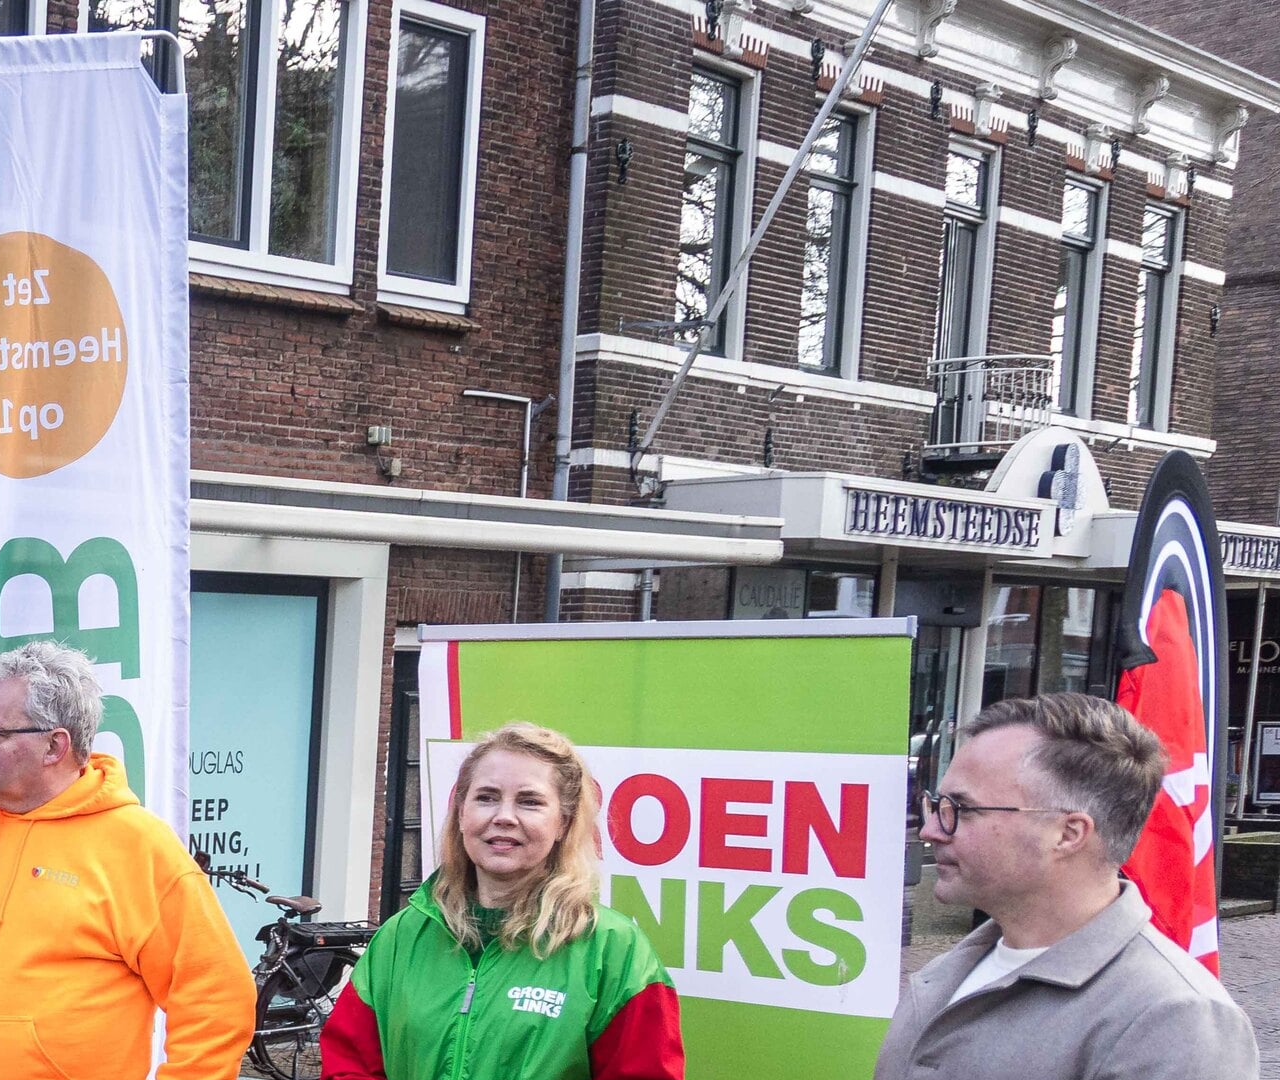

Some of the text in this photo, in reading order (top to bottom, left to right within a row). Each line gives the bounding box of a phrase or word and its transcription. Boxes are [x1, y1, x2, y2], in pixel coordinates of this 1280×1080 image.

[850, 490, 1041, 548] HEEMSTEEDSE
[189, 750, 244, 775] UGLAS
[191, 798, 229, 822] EEP
[597, 772, 870, 879] OEN
[189, 831, 249, 857] NING,
[609, 873, 868, 987] NKS
[507, 986, 567, 1005] GROEN
[512, 998, 562, 1018] LINKS
